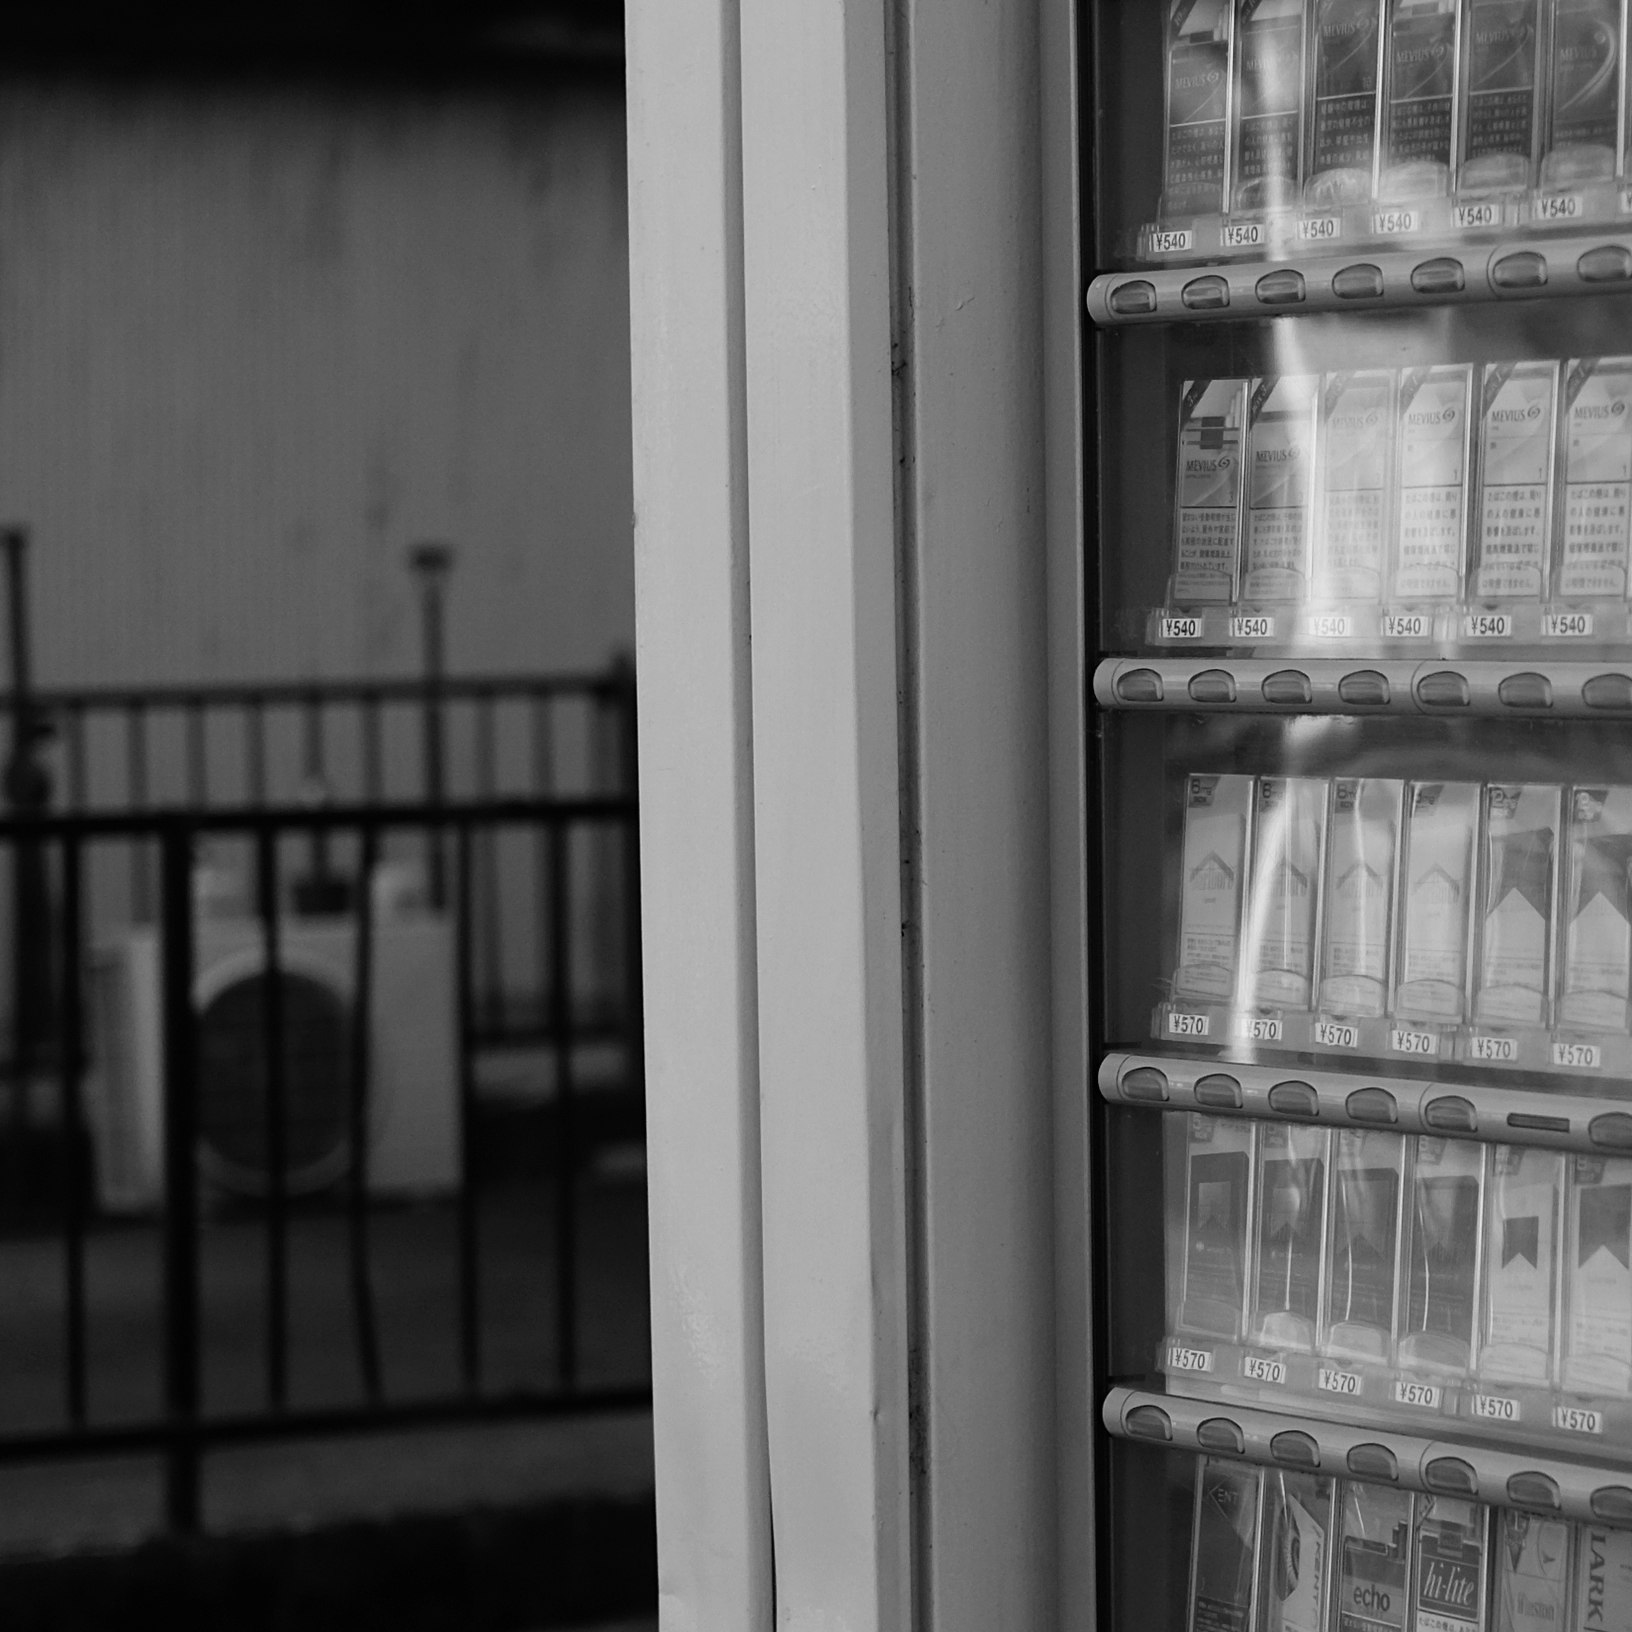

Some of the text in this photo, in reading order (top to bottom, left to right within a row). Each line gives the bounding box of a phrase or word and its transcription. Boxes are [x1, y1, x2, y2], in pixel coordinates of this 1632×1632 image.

[1458, 205, 1492, 226] ¥540
[1541, 196, 1576, 216] ¥540
[1302, 220, 1335, 238] ¥540
[1379, 213, 1412, 233] ¥540
[1155, 232, 1186, 252] ¥540
[1227, 225, 1259, 244] ¥540
[1490, 409, 1526, 424] MEVIUS
[1573, 405, 1609, 419] MEVIUS
[1166, 619, 1196, 637] ¥540
[1236, 618, 1268, 635] ¥540
[1388, 617, 1422, 635] ¥540
[1471, 615, 1505, 635] ¥540
[1551, 614, 1586, 635] ¥540
[1173, 1015, 1204, 1035] ¥570
[1320, 1024, 1352, 1045] ¥570
[1398, 1032, 1431, 1053] ¥570
[1477, 1038, 1512, 1059] ¥570
[1558, 1044, 1594, 1065] ¥570
[1175, 1351, 1206, 1371] ¥570
[1249, 1359, 1281, 1381] ¥570
[1324, 1372, 1356, 1393] ¥570
[1400, 1384, 1434, 1406] ¥570
[1480, 1399, 1514, 1418] ¥570
[1561, 1410, 1597, 1430] ¥570
[1422, 1560, 1474, 1606] hi-lite
[1587, 1532, 1606, 1623] LARK
[1353, 1584, 1391, 1612] echo
